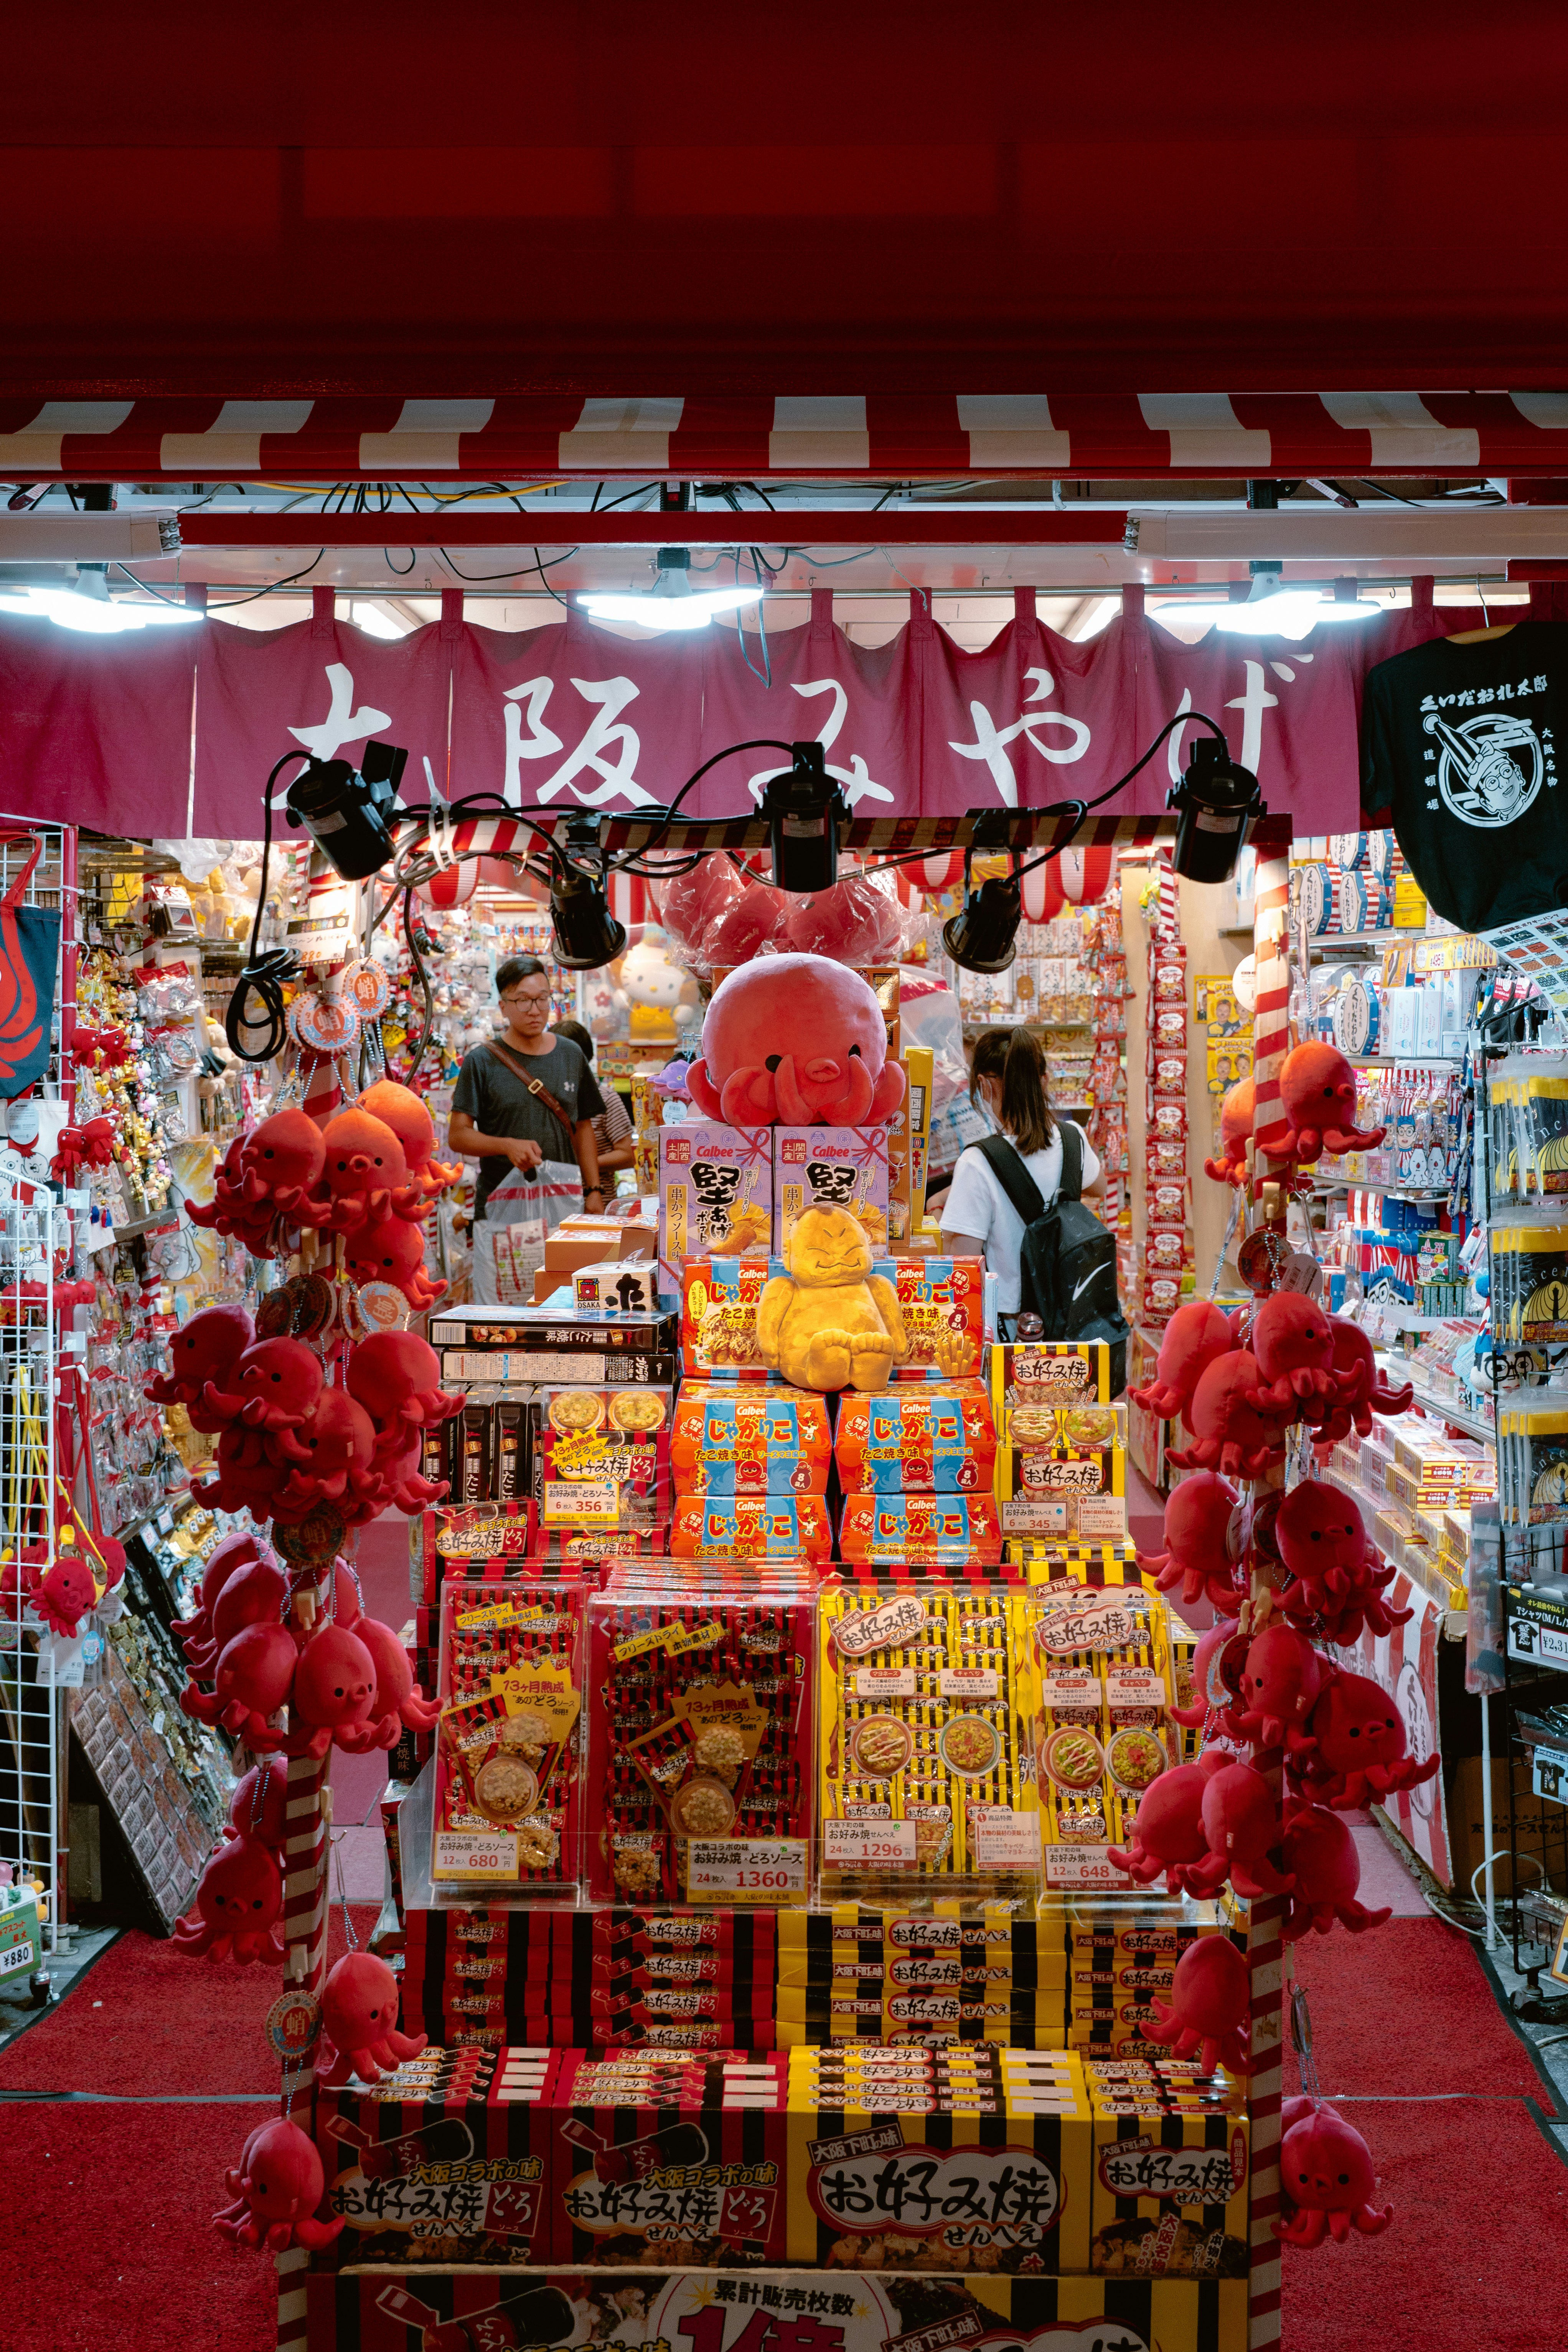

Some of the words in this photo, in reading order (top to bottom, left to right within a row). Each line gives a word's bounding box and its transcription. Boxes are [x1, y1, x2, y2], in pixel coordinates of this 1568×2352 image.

[261, 654, 1313, 810] 大阪みやげ
[1542, 728, 1558, 787] 大阪名物
[1423, 749, 1439, 810] 道頓堀
[357, 976, 375, 1000] 蛸
[318, 1008, 341, 1033] 蛸
[667, 1143, 678, 1160] 土産
[679, 1143, 690, 1160] 関西
[696, 1146, 734, 1157] Calbee
[782, 1143, 793, 1161] 土産
[795, 1143, 805, 1161] 関西
[812, 1145, 849, 1157] Calbee
[671, 1187, 683, 1260] 串かつソース味
[696, 1211, 709, 1243] ポテト
[737, 1269, 767, 1278] Calbee
[895, 1269, 924, 1278] Calbee
[954, 1271, 968, 1281] 関西
[709, 1280, 766, 1305] じゃが
[902, 1307, 939, 1319] 焼き味
[955, 1314, 962, 1323] 8
[1016, 1360, 1087, 1380] お好み焼
[737, 1406, 766, 1415] Calbee
[902, 1404, 930, 1413] Calbee
[689, 1418, 702, 1429] 関西
[709, 1418, 792, 1443] じゃがりこ
[874, 1415, 957, 1440] じゃがりこ
[695, 1449, 753, 1461] たこ焼き味
[861, 1447, 920, 1459] たこ焼き味
[633, 1457, 651, 1476] どろ
[963, 1470, 971, 1478] 8
[1025, 1465, 1100, 1486] お好み焼
[797, 1473, 805, 1482] 8
[576, 1501, 602, 1511] 356
[736, 1501, 765, 1511] Calbee
[907, 1500, 936, 1509] Calbee
[471, 1515, 527, 1532] 大阪コラボの味
[708, 1513, 792, 1538] じゃがりこ
[879, 1511, 963, 1536] じゃがりこ
[1029, 1520, 1050, 1529] 345
[505, 1529, 522, 1547] どろ
[694, 1545, 753, 1557] たこ焼き味
[865, 1543, 924, 1555] たこ焼き味
[460, 1605, 509, 1624] フリーズドライ
[1045, 1611, 1126, 1647] お好み焼
[619, 1626, 679, 1656] フリーズドライ
[829, 1830, 895, 1840] お好み焼せんべえ
[862, 1844, 902, 1856] 1296
[1049, 1854, 1109, 1863] お好み焼せんべえ
[443, 1856, 454, 1864] 12
[469, 1855, 498, 1867] 680
[697, 1874, 709, 1883] 24
[736, 1871, 787, 1887] 1360
[1053, 1867, 1066, 1875] 12
[1080, 1865, 1110, 1878] 648
[701, 1925, 717, 1941] どろ
[834, 1927, 884, 1940] 大阪下町の味
[893, 1925, 962, 1947] お好み焼
[3, 1946, 29, 1967] ¥880
[834, 1964, 884, 1978] 大阪下町の味
[893, 1962, 962, 1986] お好み焼
[834, 2001, 883, 2014] 大阪下町の味
[892, 1997, 961, 2020] お好み焼
[814, 2127, 900, 2164] 大阪下町の味
[1101, 2136, 1152, 2158] 大阪下町の味
[1233, 2137, 1244, 2178] 商品見本
[411, 2158, 543, 2187] 大阪コラボの味
[646, 2162, 777, 2190] 大阪コラボの味
[1106, 2154, 1236, 2192] お好み焼
[329, 2177, 485, 2223] お好み焼
[492, 2185, 531, 2223] どろ
[820, 2159, 1053, 2225] お好み焼
[564, 2181, 720, 2227] お好み焼
[727, 2189, 767, 2230] どろ
[714, 2279, 855, 2317] 累計販売枚数
